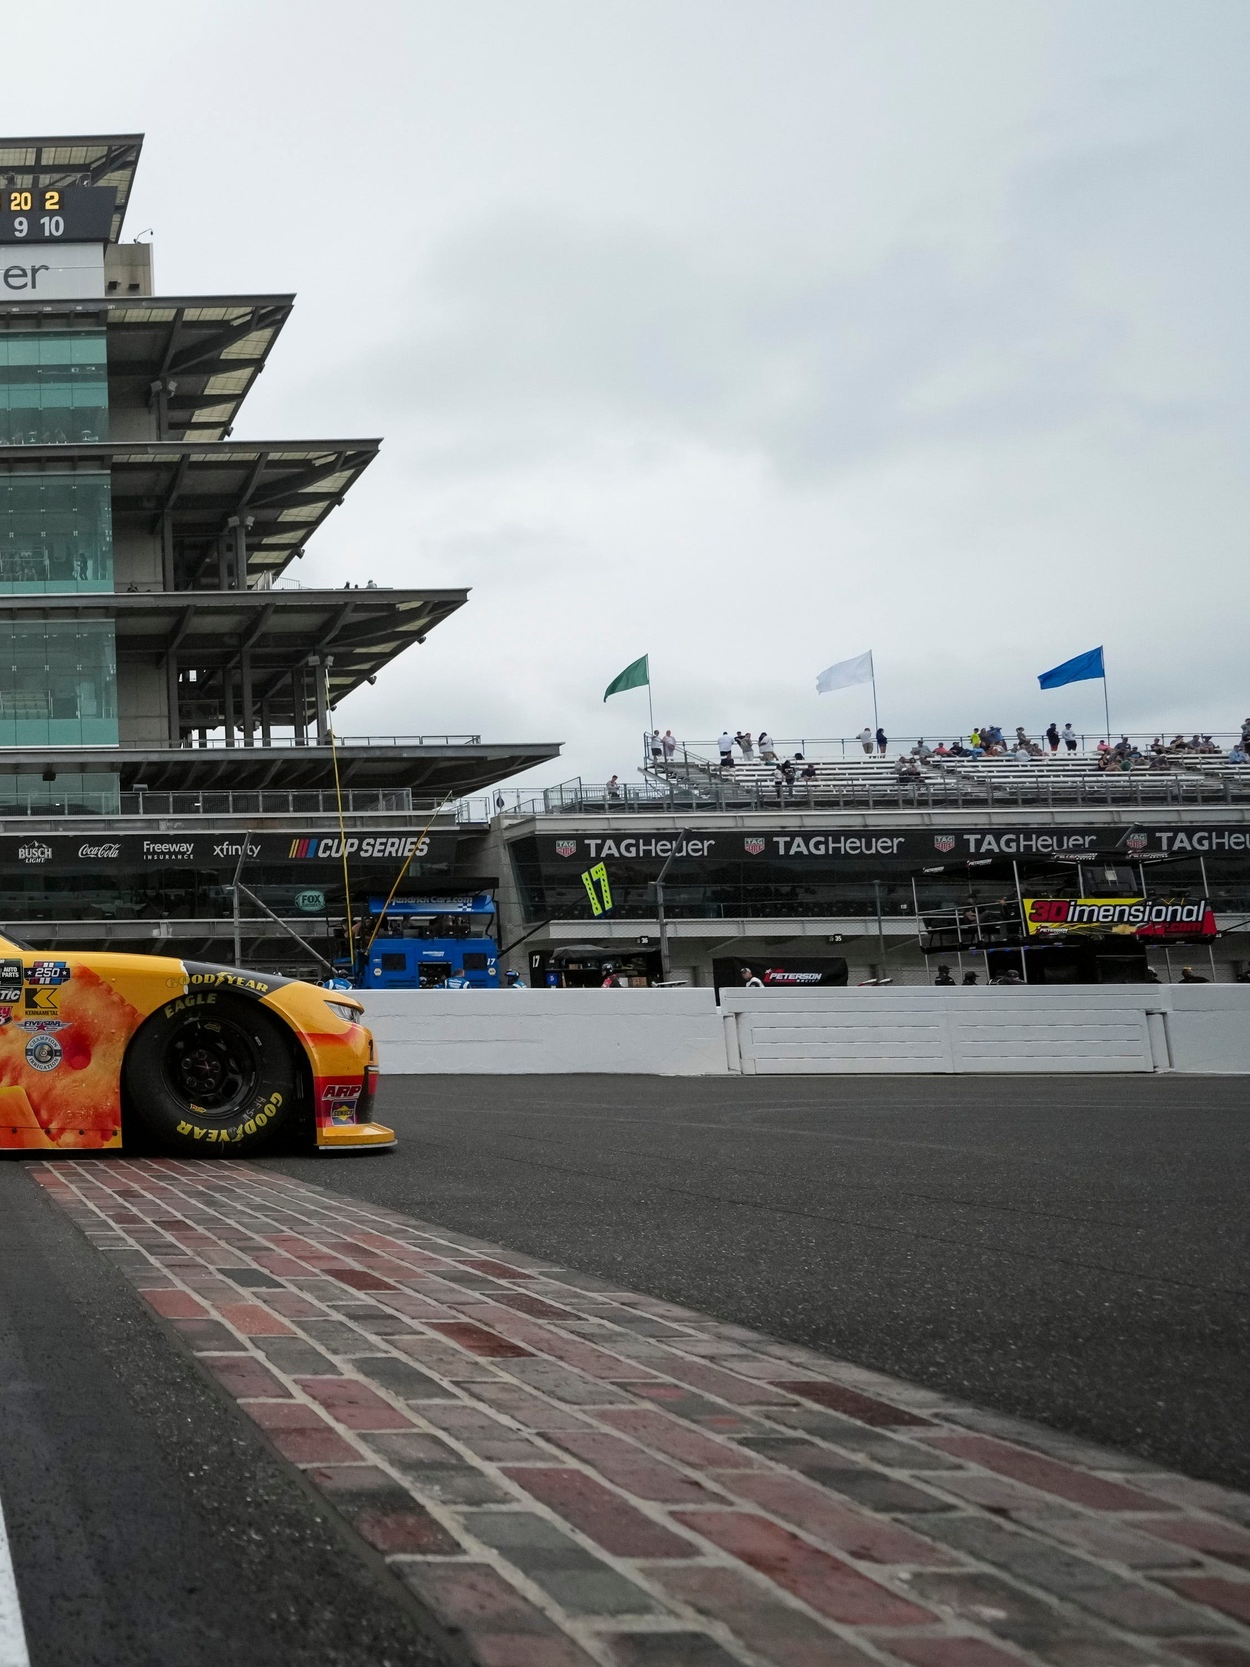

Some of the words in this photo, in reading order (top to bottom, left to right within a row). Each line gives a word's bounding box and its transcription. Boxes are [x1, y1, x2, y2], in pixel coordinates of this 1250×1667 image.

[10, 192, 31, 211] 20
[44, 191, 60, 210] 2
[14, 217, 28, 237] 9
[40, 216, 65, 237] 10
[18, 848, 53, 860] BUSCH
[143, 841, 194, 855] Freeway
[317, 838, 359, 858] CUP
[360, 837, 430, 857] SERIES
[581, 862, 613, 916] 17
[301, 894, 321, 904] FOX
[487, 957, 497, 966] 17
[532, 955, 541, 968] 17
[34, 967, 60, 977] 250
[166, 972, 269, 992] GOODYEAR
[164, 993, 218, 1019] EAGLE
[29, 1036, 59, 1048] CHAMPION
[28, 1057, 59, 1070] IRRIGATION
[323, 1085, 362, 1098] ARP
[176, 1092, 283, 1143] GOODYEAR
[333, 1109, 354, 1117] SUNOCO
